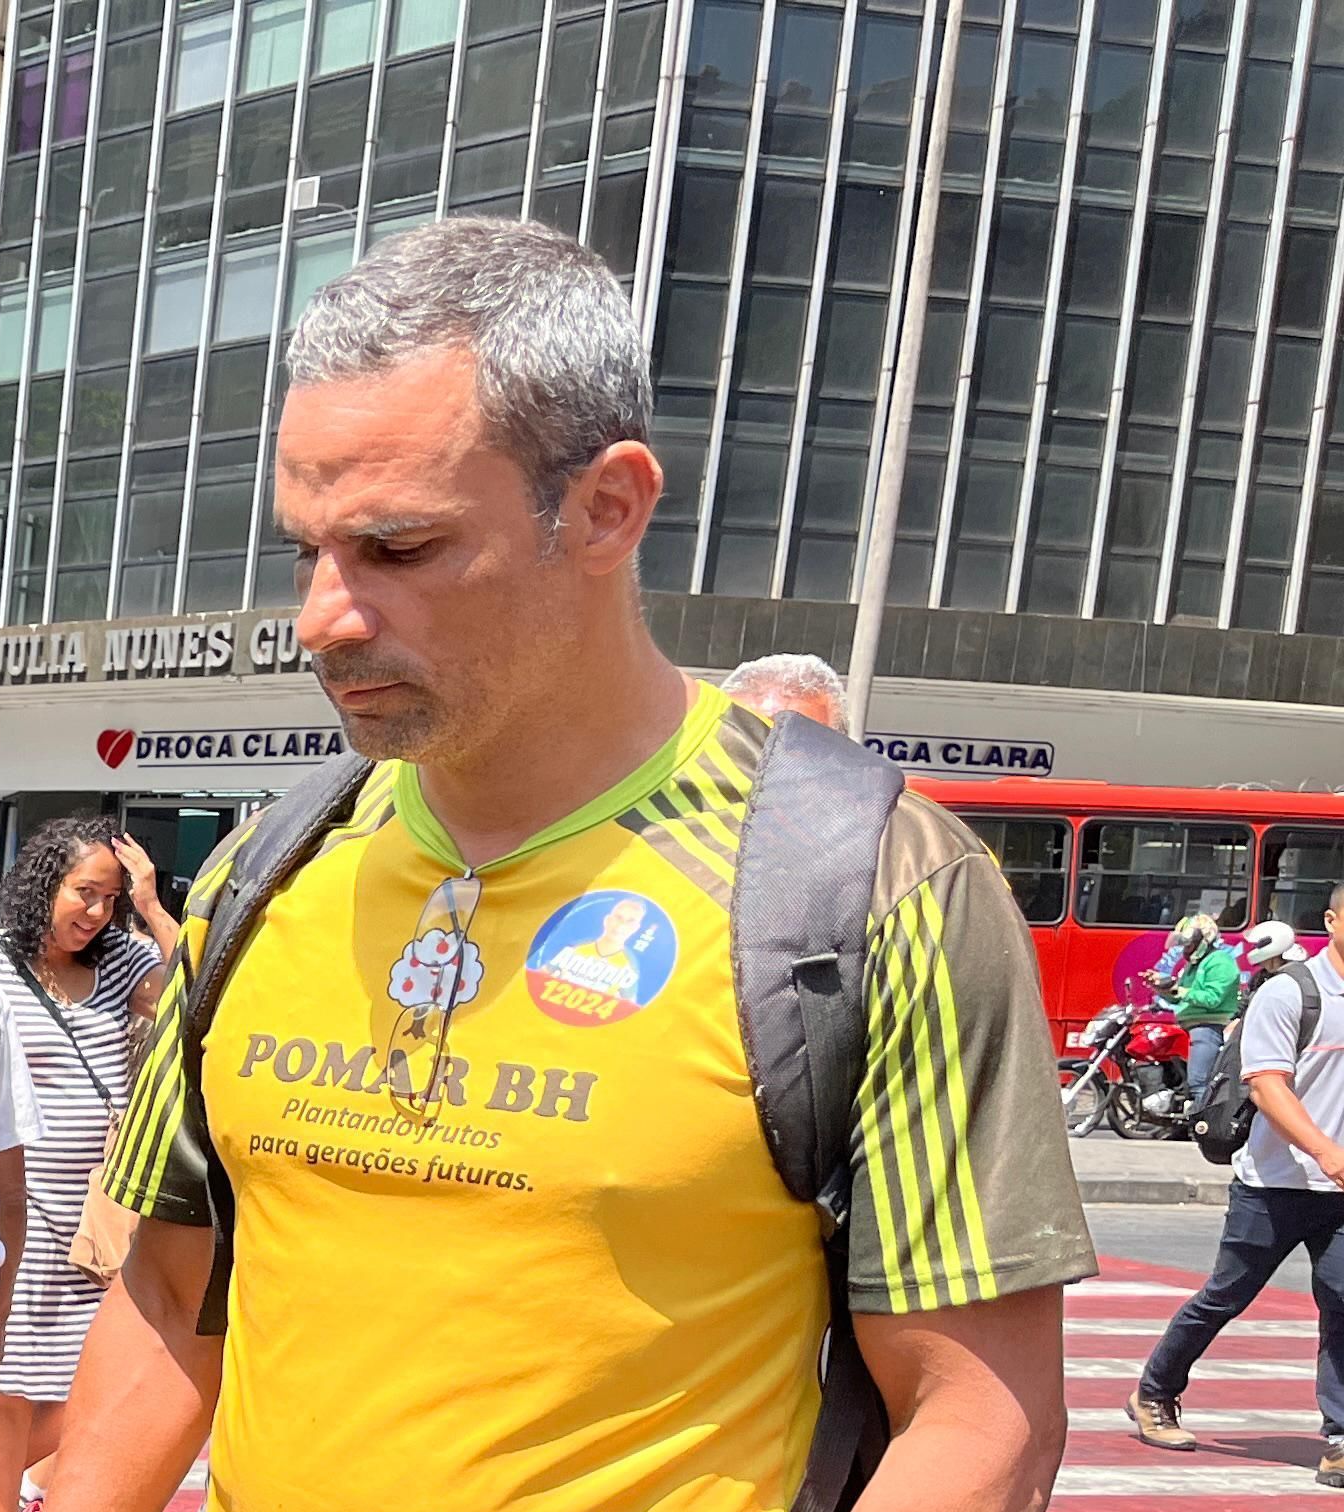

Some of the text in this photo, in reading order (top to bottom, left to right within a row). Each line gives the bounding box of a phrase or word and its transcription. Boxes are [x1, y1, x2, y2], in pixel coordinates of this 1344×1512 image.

[102, 622, 233, 671] NUNES
[135, 731, 343, 760] DROGA CLARA
[941, 743, 1050, 770] CLARA
[539, 979, 619, 1020] 12024
[237, 1033, 599, 1122] POMAR BH
[281, 1097, 502, 1150] Plantando frutos
[248, 1133, 534, 1192] para gerações futuras.
